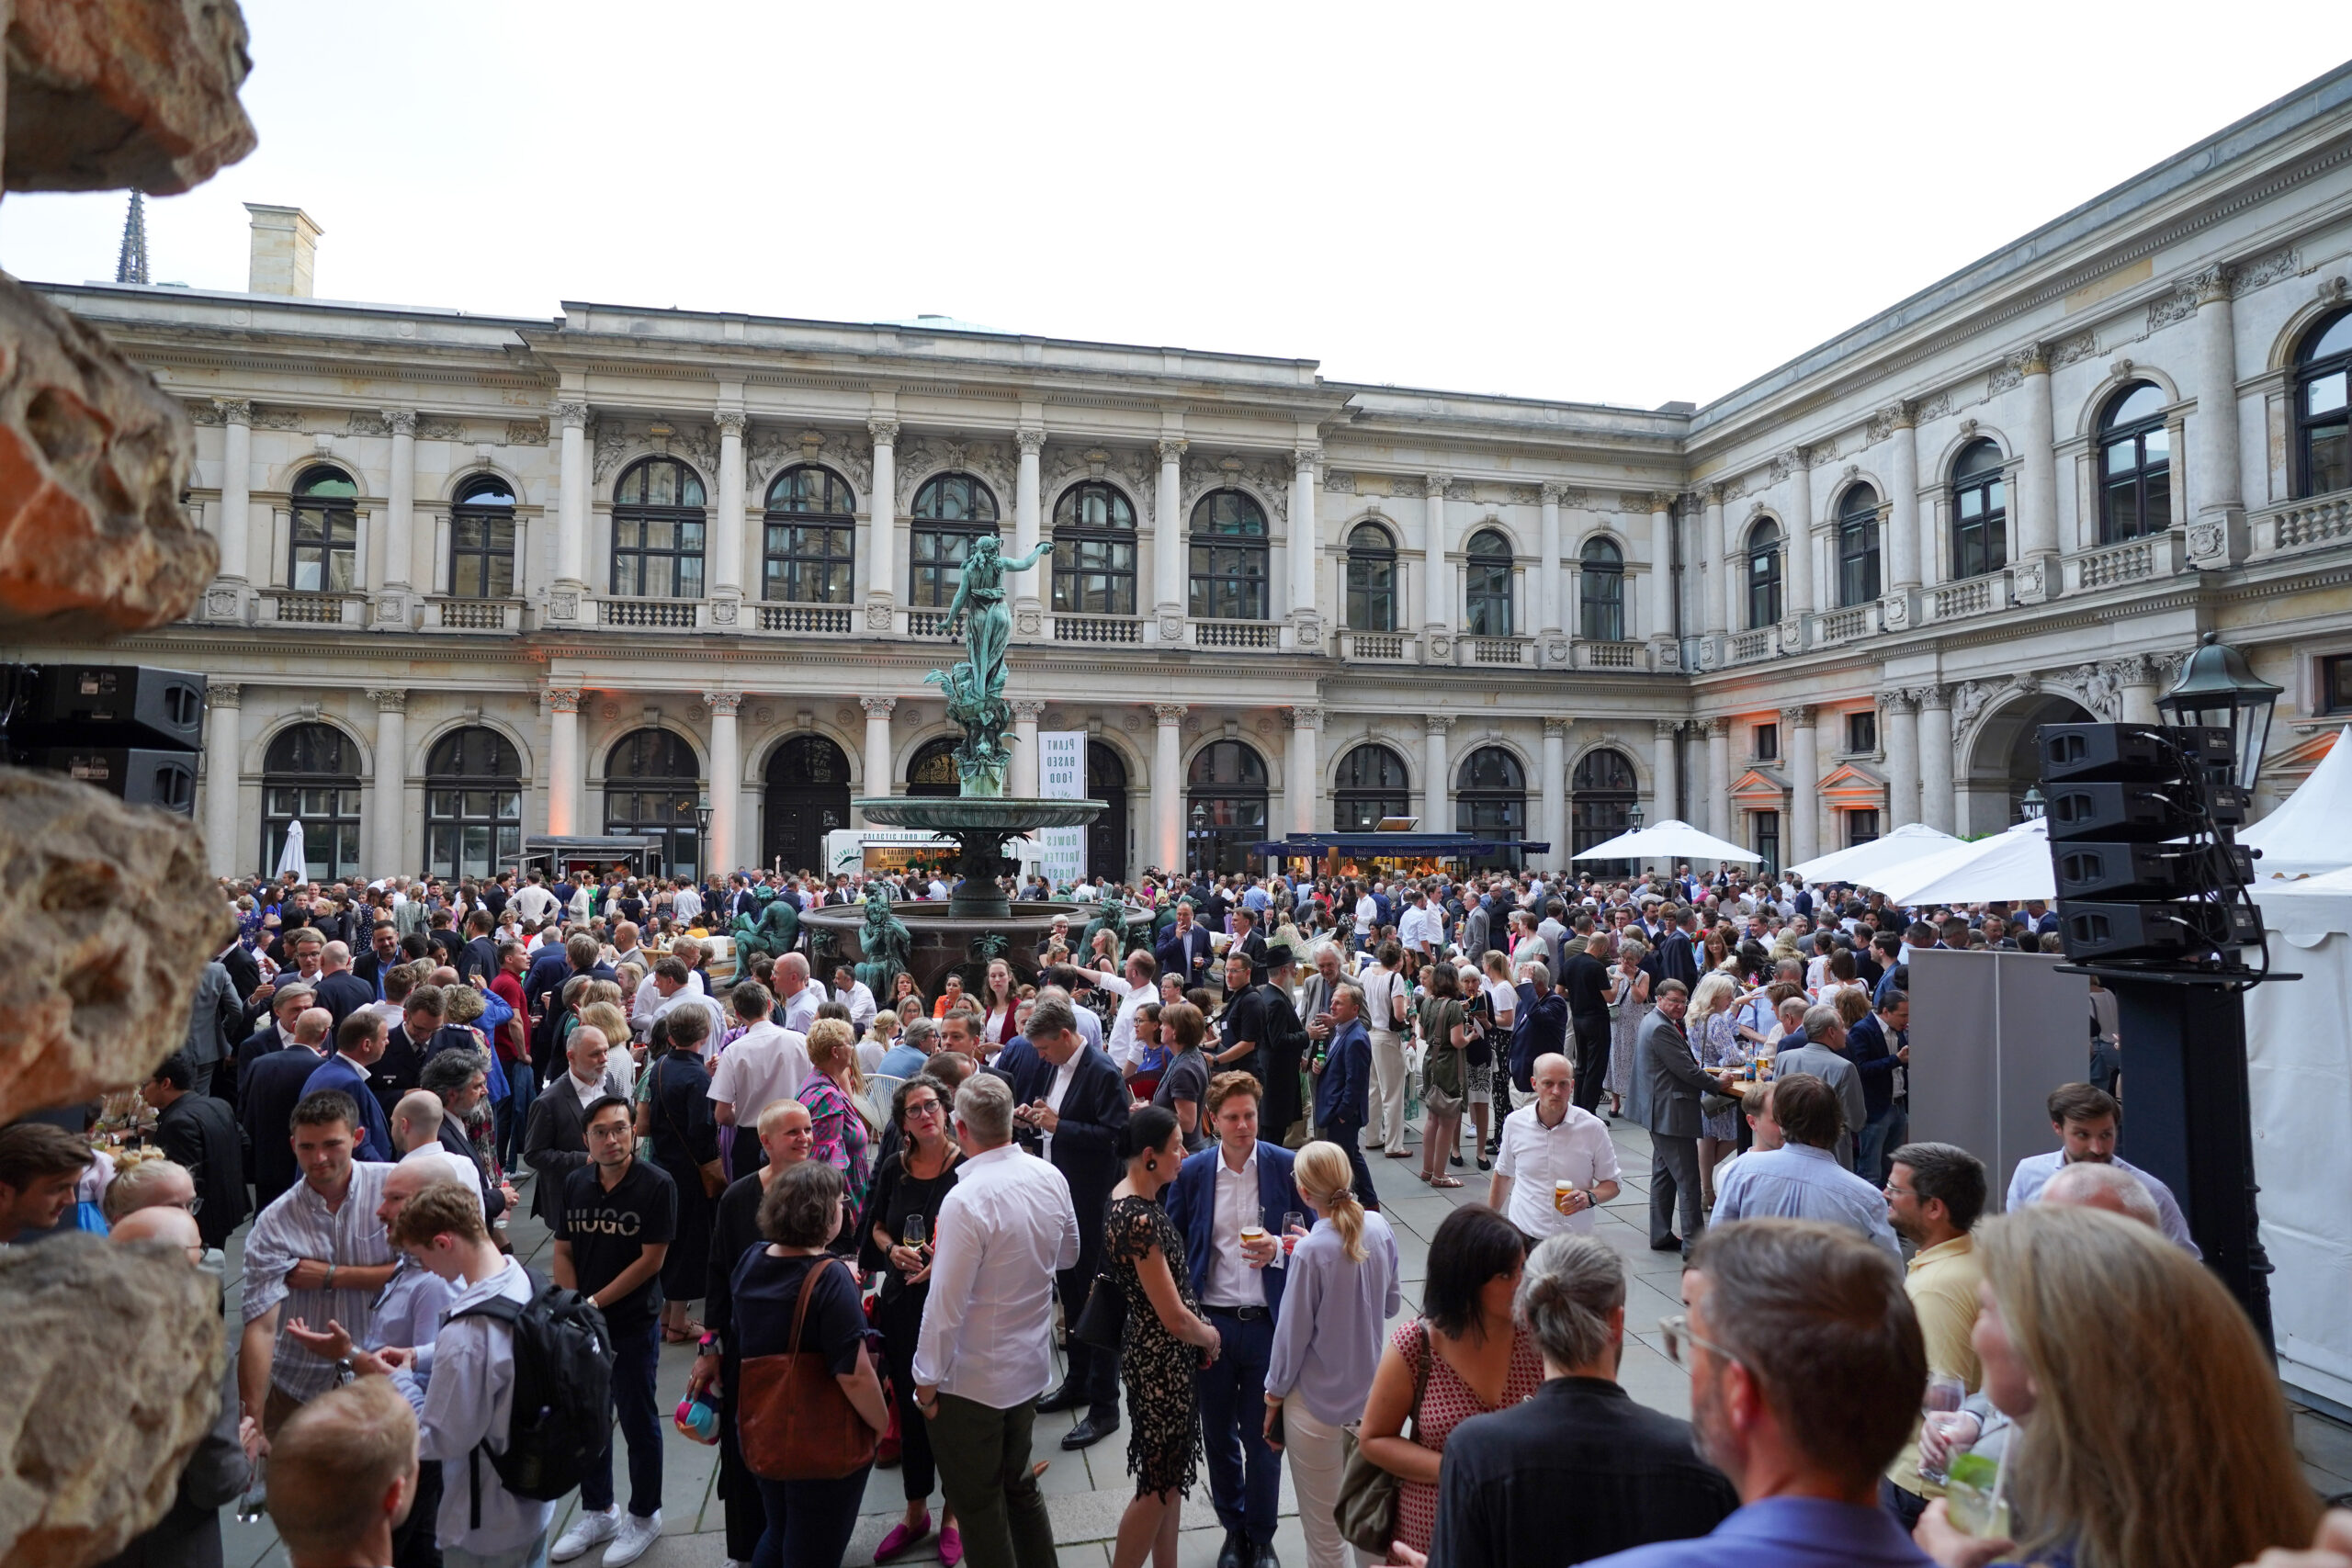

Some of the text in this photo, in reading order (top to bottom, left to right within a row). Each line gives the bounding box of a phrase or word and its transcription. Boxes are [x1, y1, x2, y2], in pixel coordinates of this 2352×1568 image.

[863, 832, 897, 840] GALACTIC
[1289, 847, 1311, 855] Imbiss
[567, 1208, 640, 1235] HUGO
